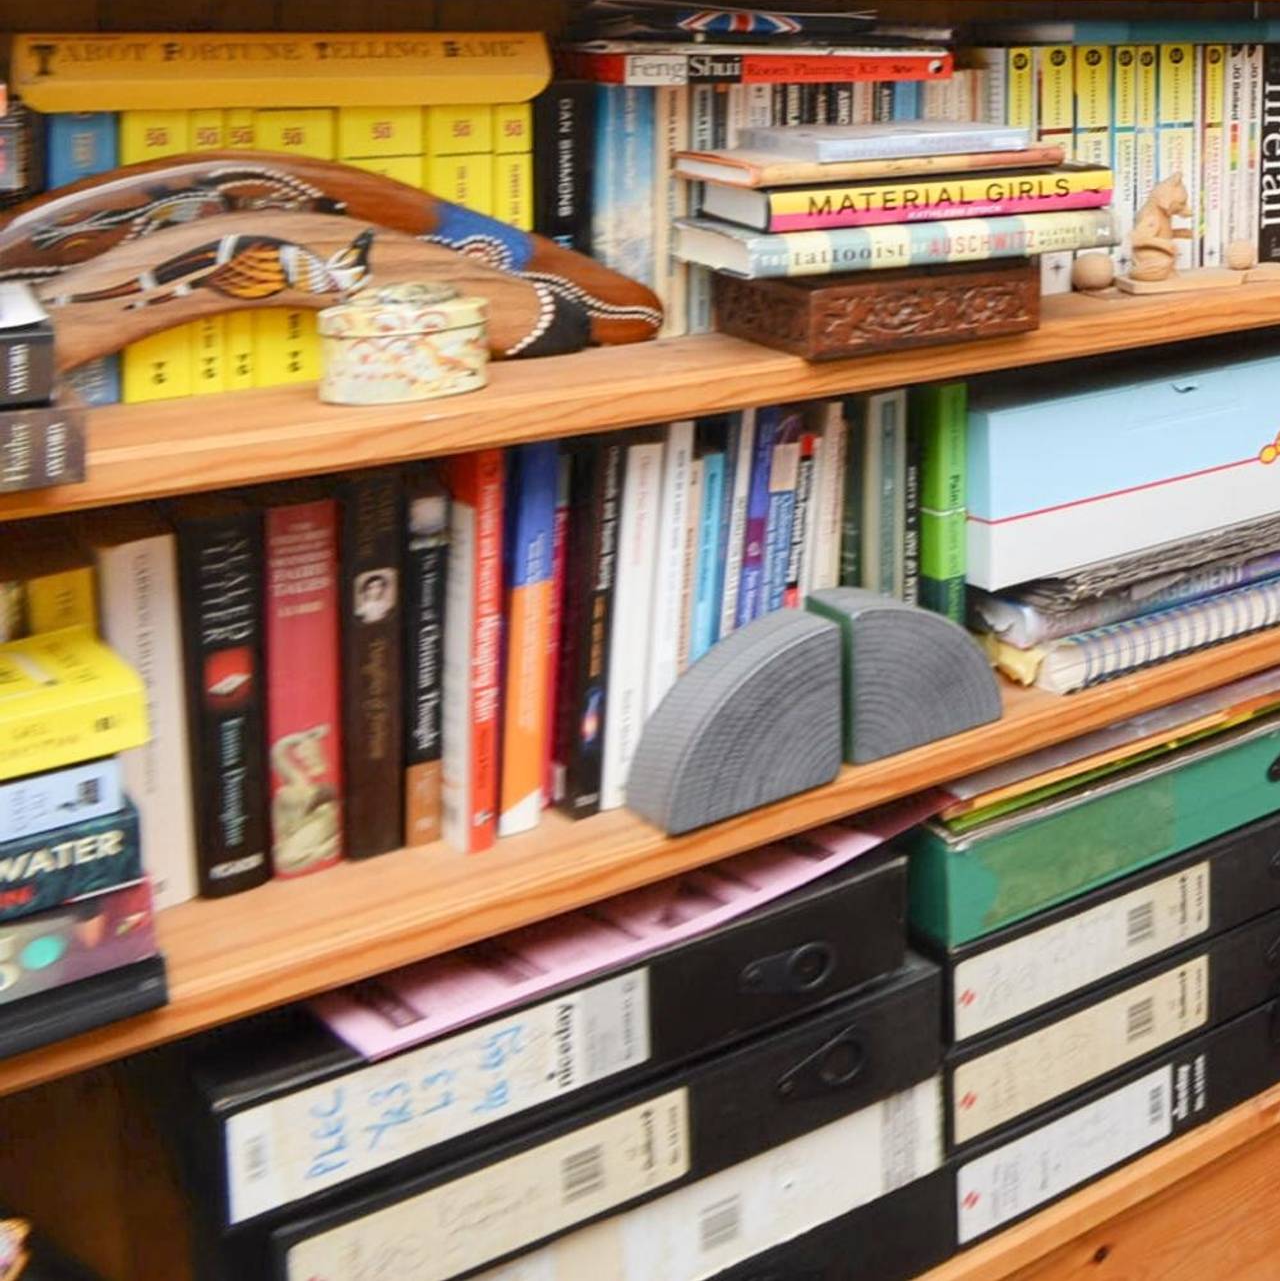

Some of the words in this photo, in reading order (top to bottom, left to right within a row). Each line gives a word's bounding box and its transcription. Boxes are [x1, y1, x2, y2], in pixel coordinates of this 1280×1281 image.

[29, 42, 147, 78] TAROT
[162, 41, 302, 63] FORTUNE
[314, 40, 430, 62] TELLING
[629, 56, 685, 80] Feng
[688, 54, 740, 77] Shui
[559, 98, 574, 135] DAN
[806, 183, 975, 216] MATERIAL
[985, 177, 1071, 203] GIRLS
[793, 242, 906, 267] tattooist
[928, 230, 1036, 258] AUSCHWITZ
[0, 829, 125, 882] WATER
